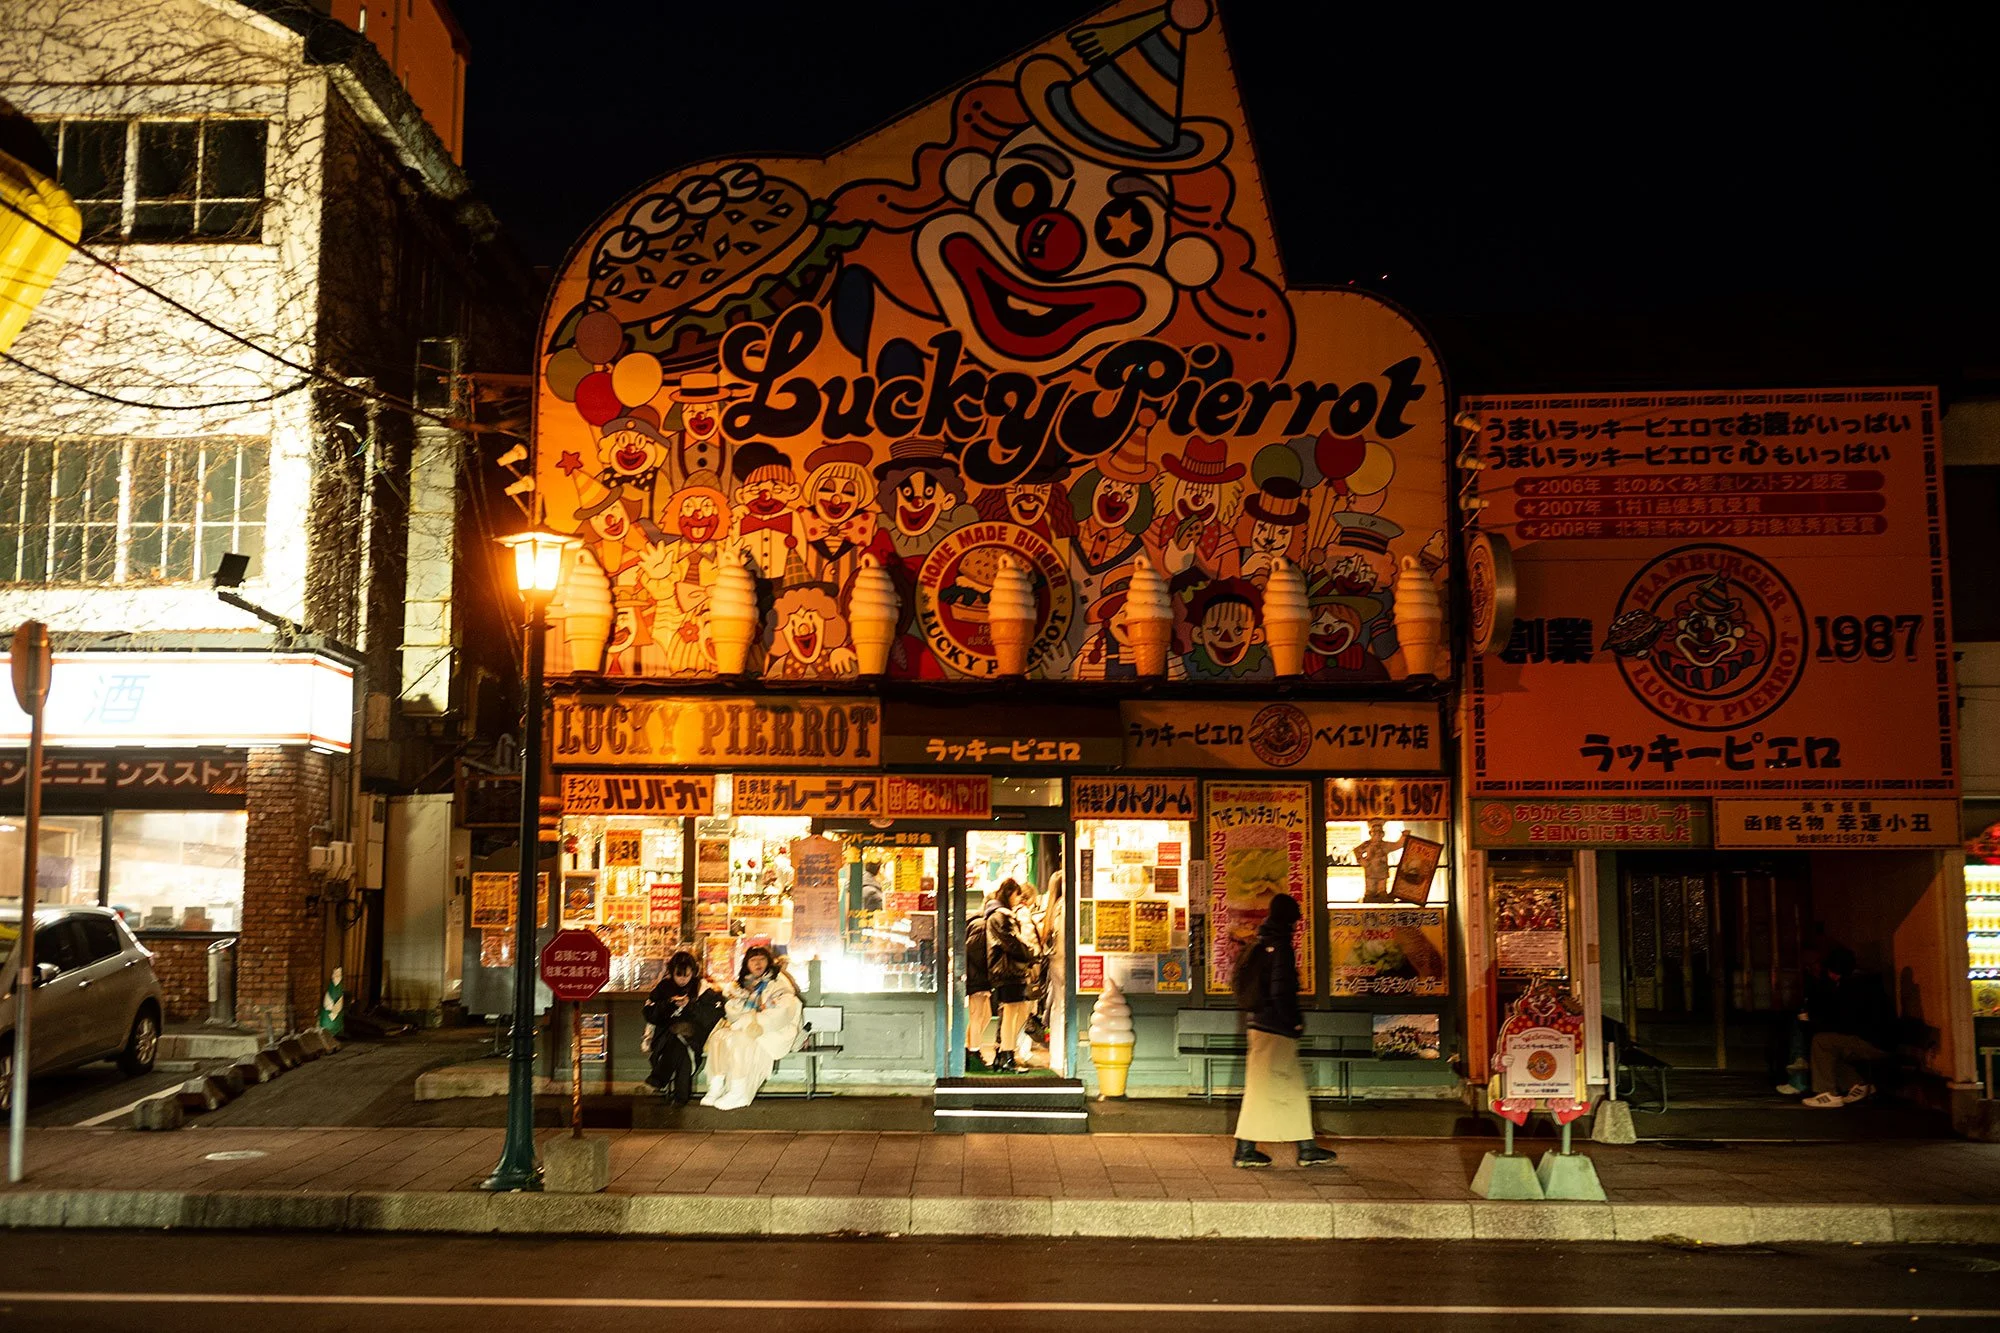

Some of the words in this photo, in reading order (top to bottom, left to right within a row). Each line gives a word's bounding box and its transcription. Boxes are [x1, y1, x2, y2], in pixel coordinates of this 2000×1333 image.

[719, 302, 1072, 487] Lucky
[1055, 338, 1426, 456] Pierrot
[1486, 411, 1911, 442] うまいラッキーピエロでお腹がいっぱい
[1486, 438, 1891, 470] うまいラッキーピエロで心もいっぱい
[1538, 477, 1601, 494] 2006年
[1539, 499, 1602, 515] 2007年
[1540, 520, 1603, 537] 2008年
[920, 543, 957, 588] HOME
[956, 525, 1008, 548] MADE
[1014, 529, 1068, 589] BURGER
[1632, 552, 1787, 610] HAMBURGER
[921, 610, 981, 670] LUCKY
[986, 610, 1066, 675] PRROT
[1814, 615, 1923, 663] 1987
[1632, 664, 1712, 722] LUCKY
[1721, 631, 1799, 723] PIERROT
[82, 673, 153, 725] 酒
[557, 702, 682, 756] LUCKY
[697, 702, 878, 758] PIERROT
[1129, 722, 1244, 747] ラッキーピエロ
[1315, 723, 1429, 750] ベイエリア本店
[926, 738, 1081, 762] ラッキーピエロ
[1579, 731, 1842, 772] ラッキーピエロ
[603, 779, 708, 810] ハンバーガー
[772, 779, 878, 811] カレーライス
[888, 781, 987, 812] 函館おみやげ
[1077, 784, 1192, 814] 特製ソフトクリーム
[1331, 783, 1395, 816] SINCE
[1399, 784, 1444, 817] 1987
[1744, 814, 1825, 832] 函館名物
[1836, 813, 1932, 832] 幸運小丑
